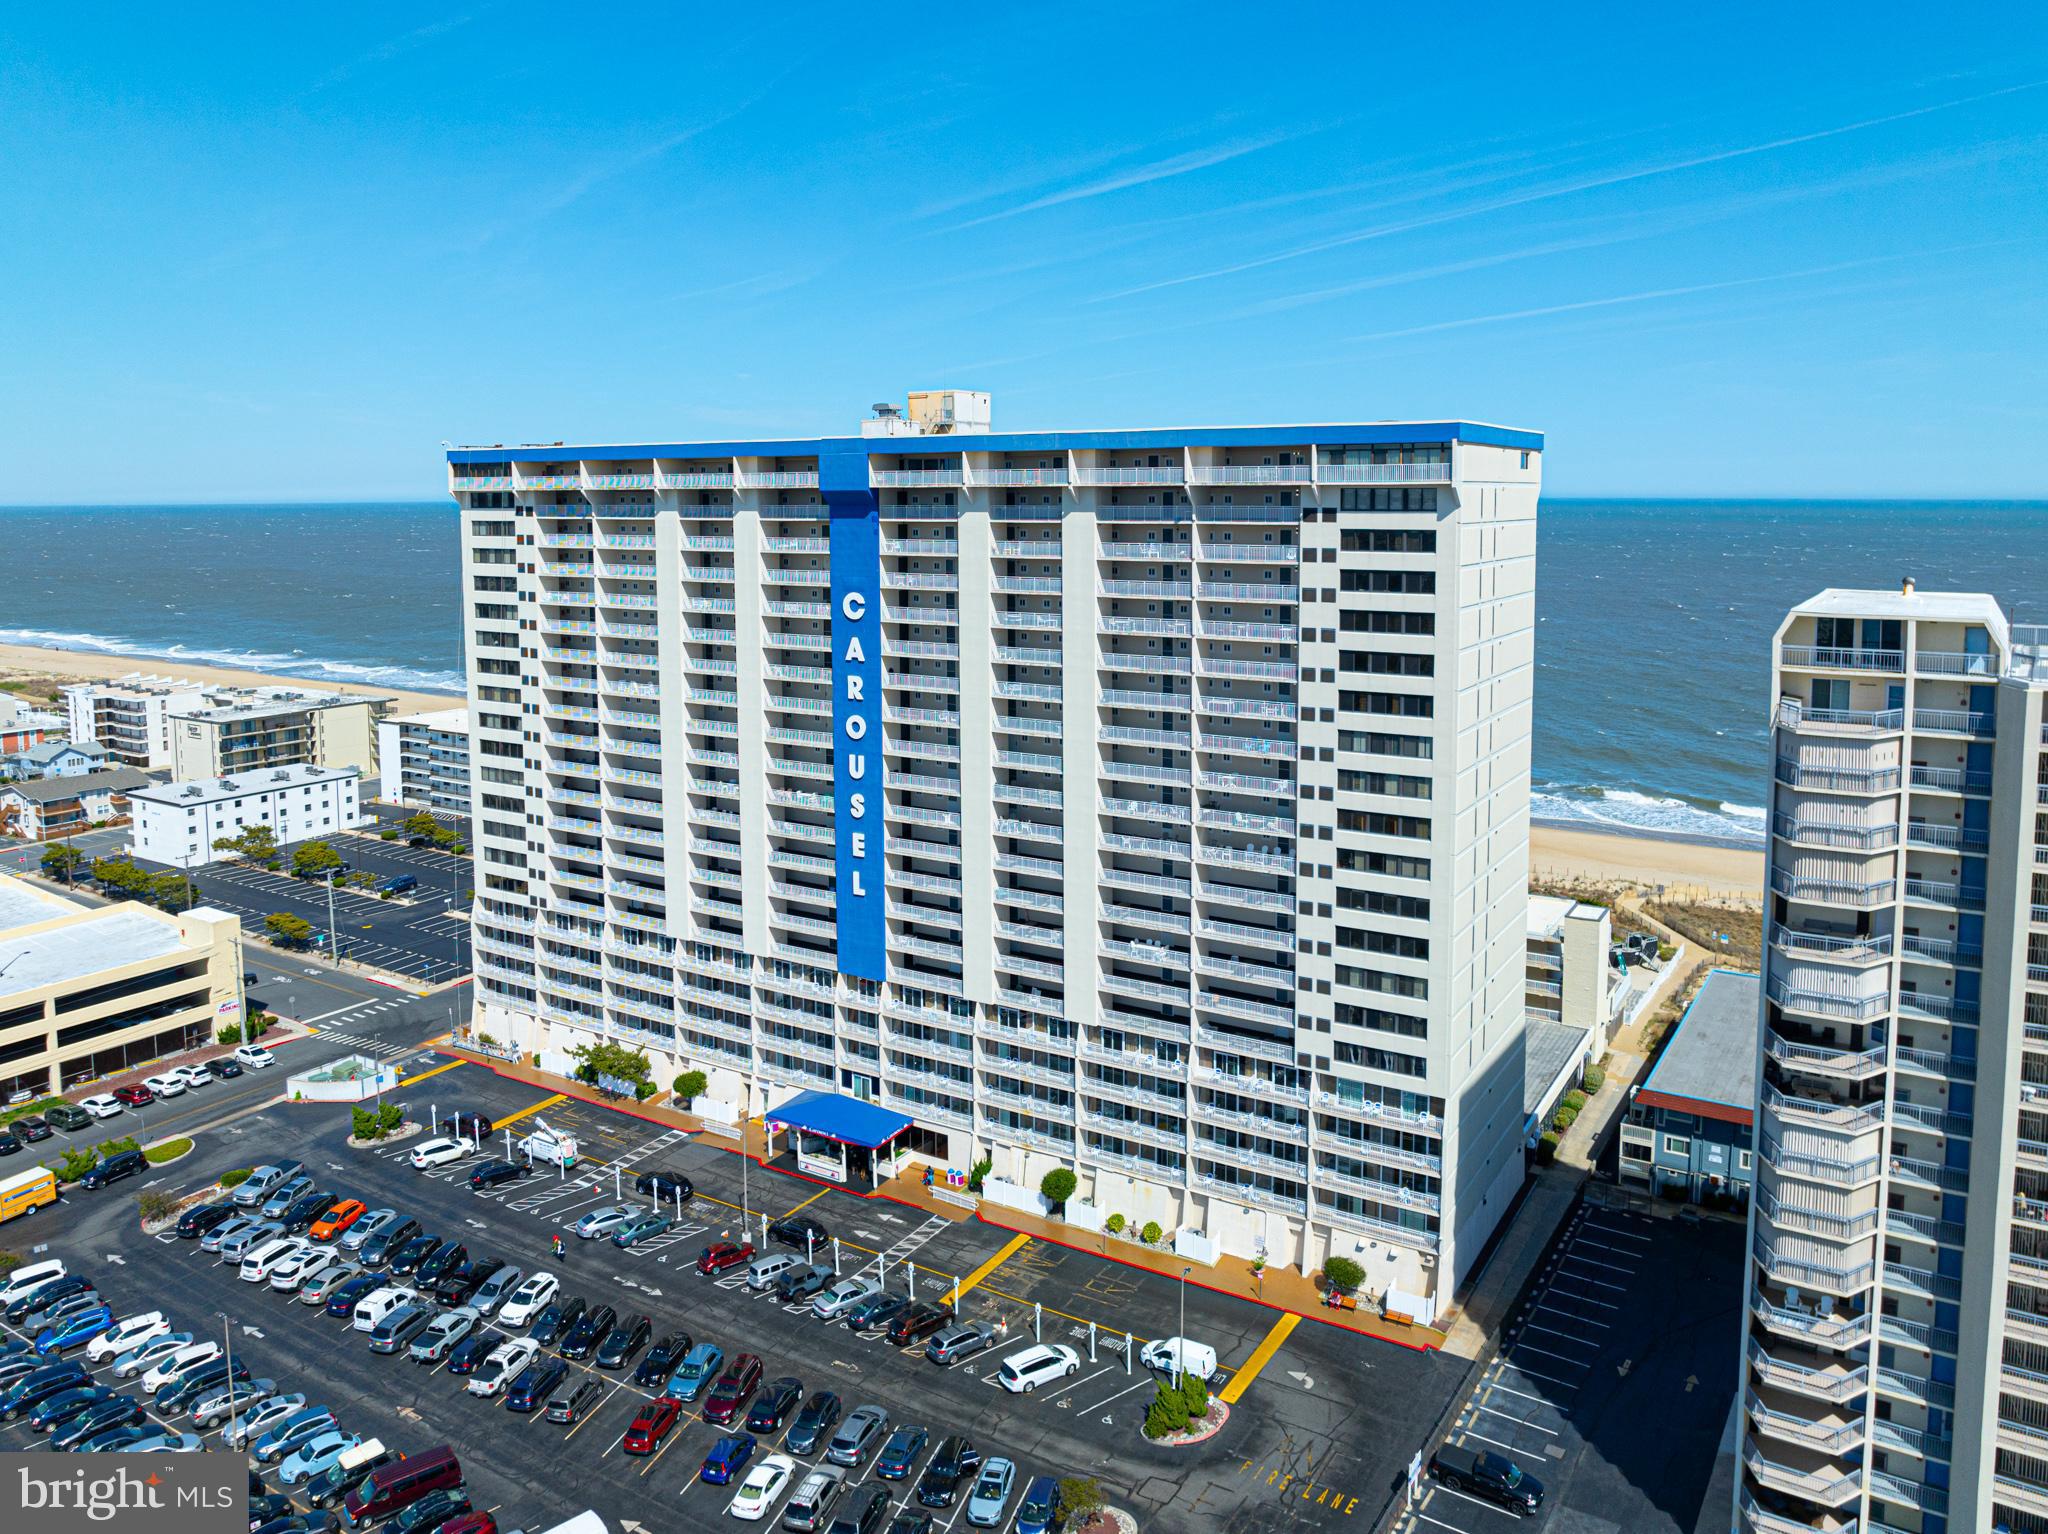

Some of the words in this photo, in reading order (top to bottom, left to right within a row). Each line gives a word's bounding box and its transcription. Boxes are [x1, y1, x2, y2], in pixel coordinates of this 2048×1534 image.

[842, 592, 867, 896] CAROUSEL
[1069, 1326, 1091, 1339] ZONE
[1098, 1336, 1129, 1352] LOADING
[1238, 1460, 1294, 1492] FIRE
[1302, 1483, 1360, 1515] LANE
